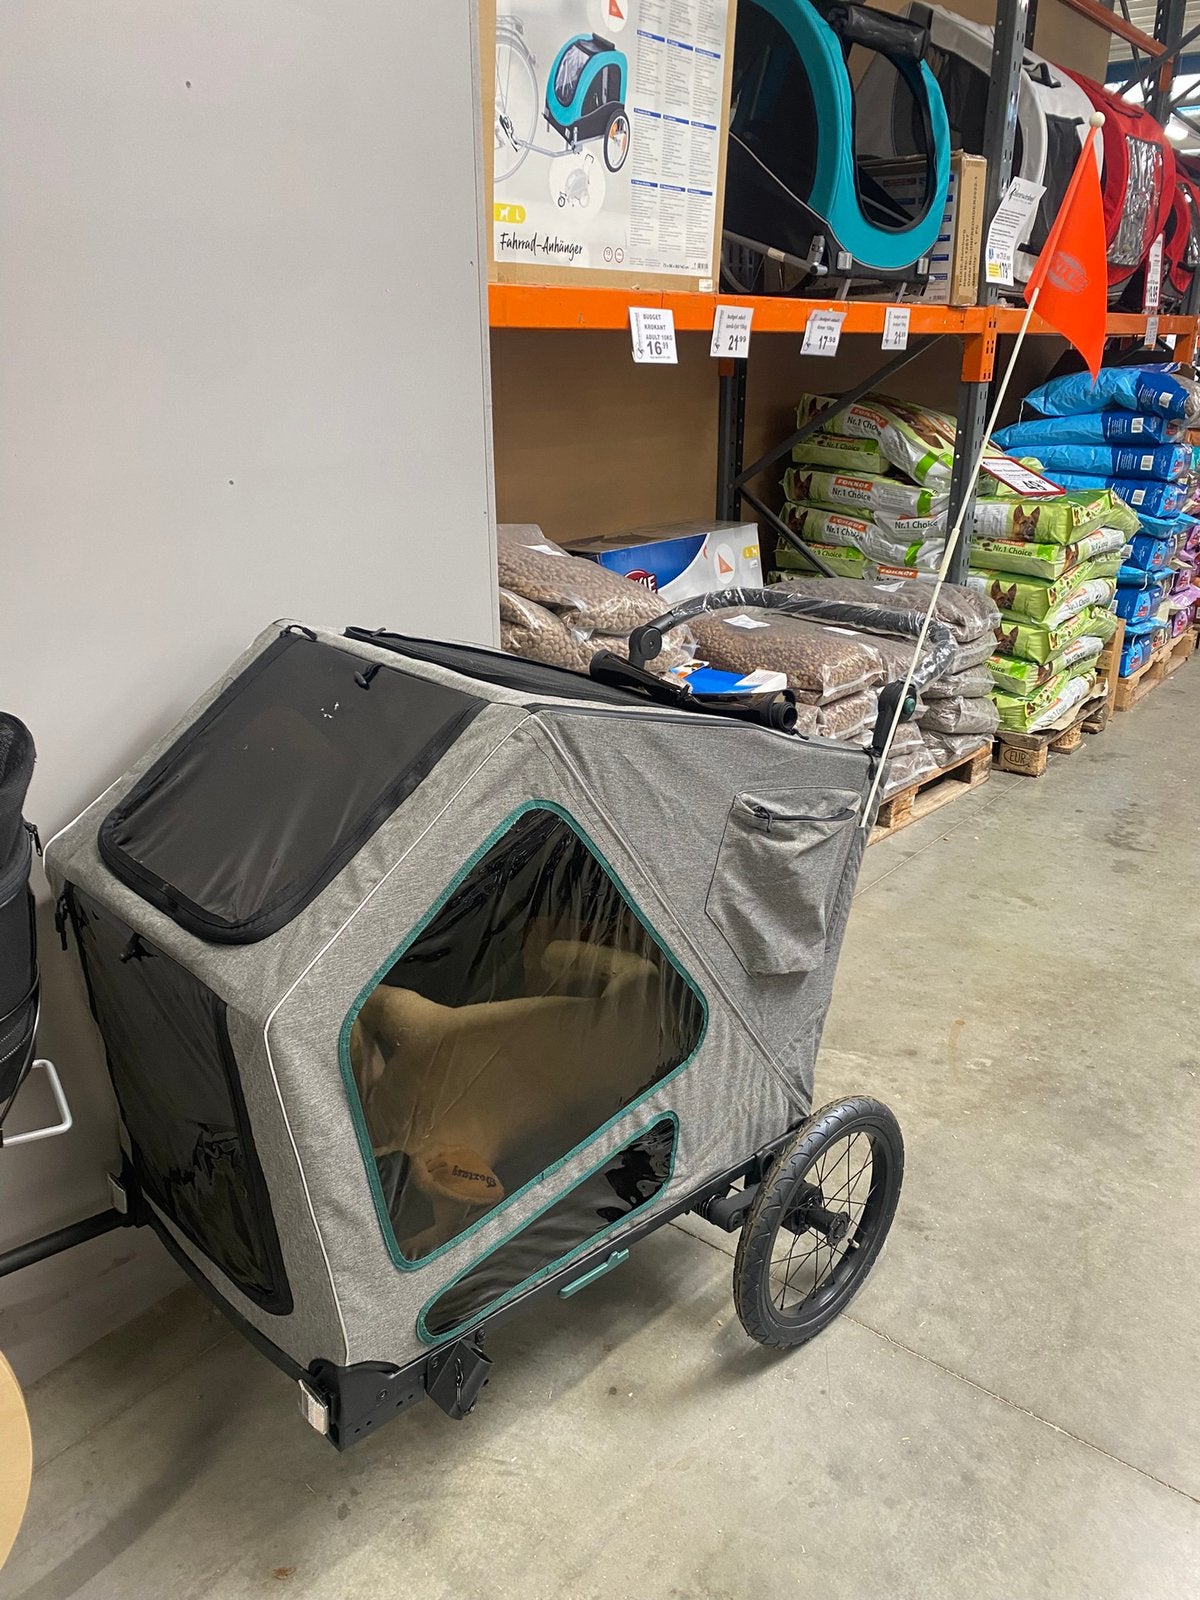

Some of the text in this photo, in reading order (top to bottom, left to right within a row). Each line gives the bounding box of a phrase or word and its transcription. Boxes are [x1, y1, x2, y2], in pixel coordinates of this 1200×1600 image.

[500, 232, 583, 261] Fahrrad-Anhänger
[832, 487, 871, 501] Nr.1 Choice
[894, 521, 910, 529] Nr.1
[993, 544, 1033, 557] Nr.1 Choice
[1010, 750, 1026, 764] EUR
